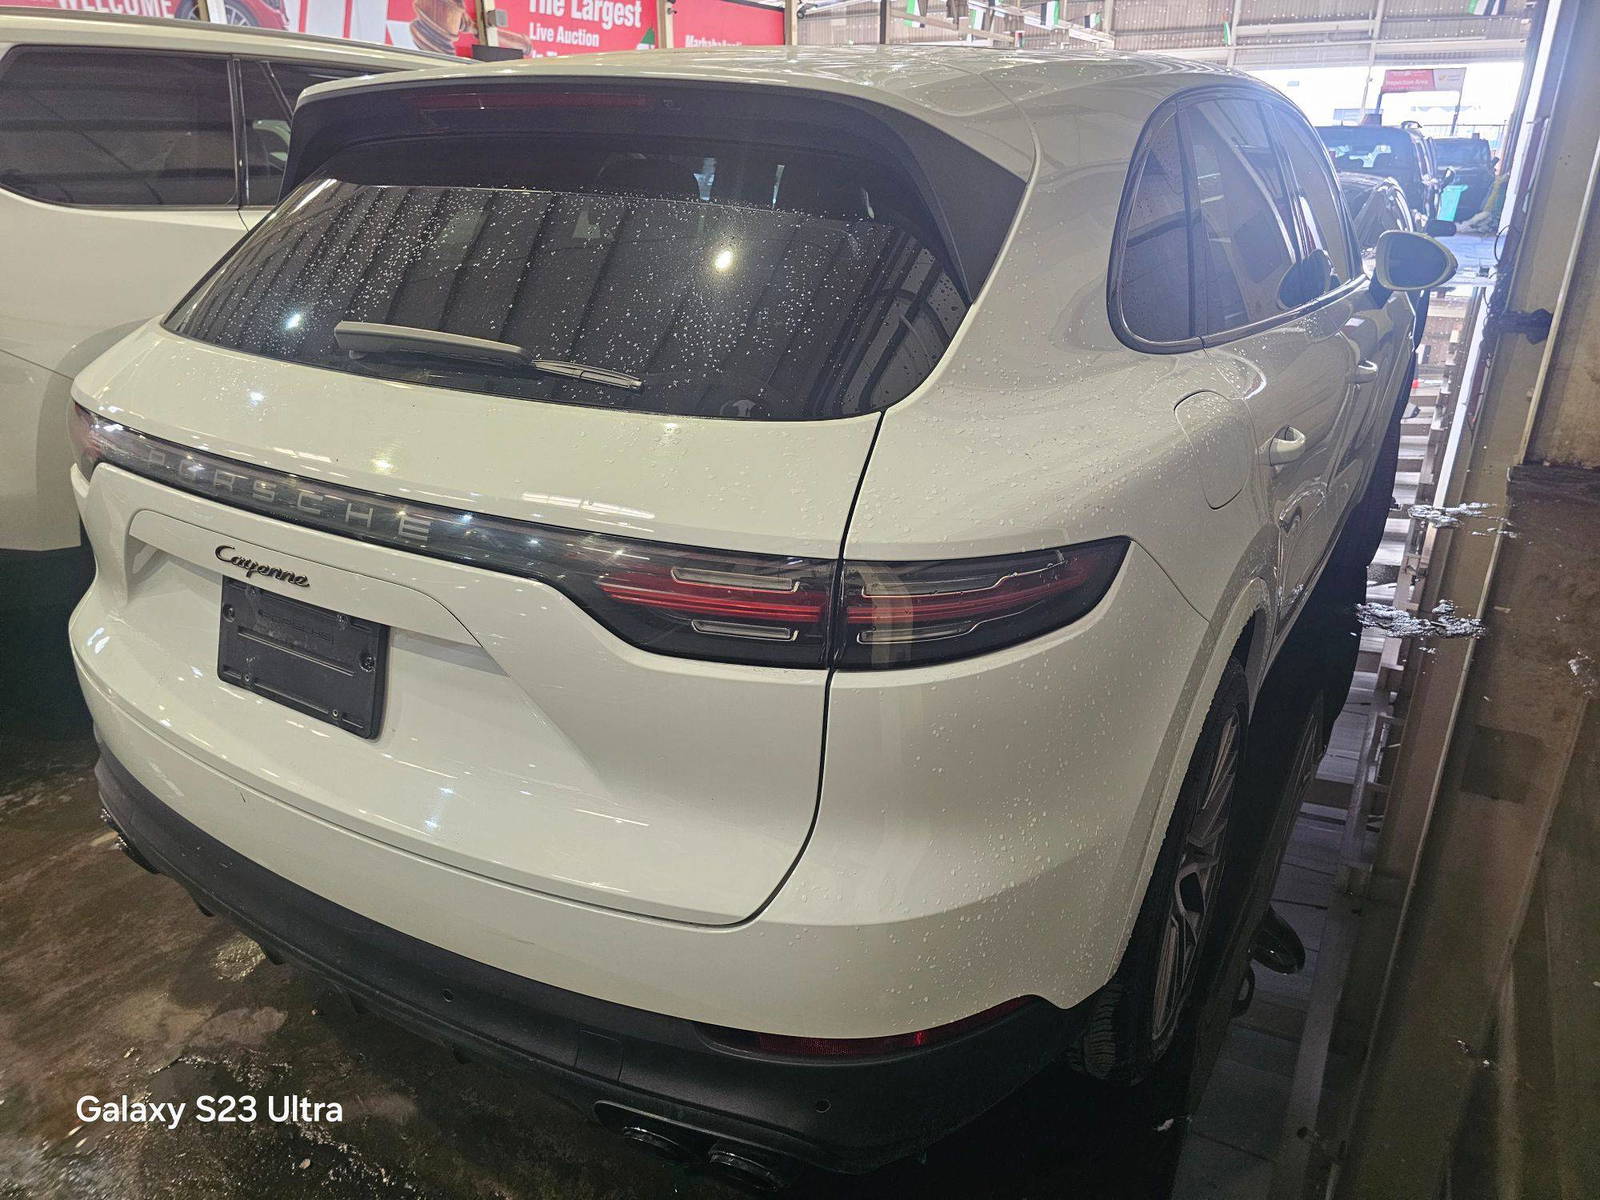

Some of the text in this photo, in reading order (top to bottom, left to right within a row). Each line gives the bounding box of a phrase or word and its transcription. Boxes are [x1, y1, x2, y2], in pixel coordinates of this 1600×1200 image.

[570, 0, 642, 30] Largest
[528, 22, 600, 47] Live Auction
[147, 449, 432, 541] PORSCHE
[214, 545, 311, 588] Cayenne
